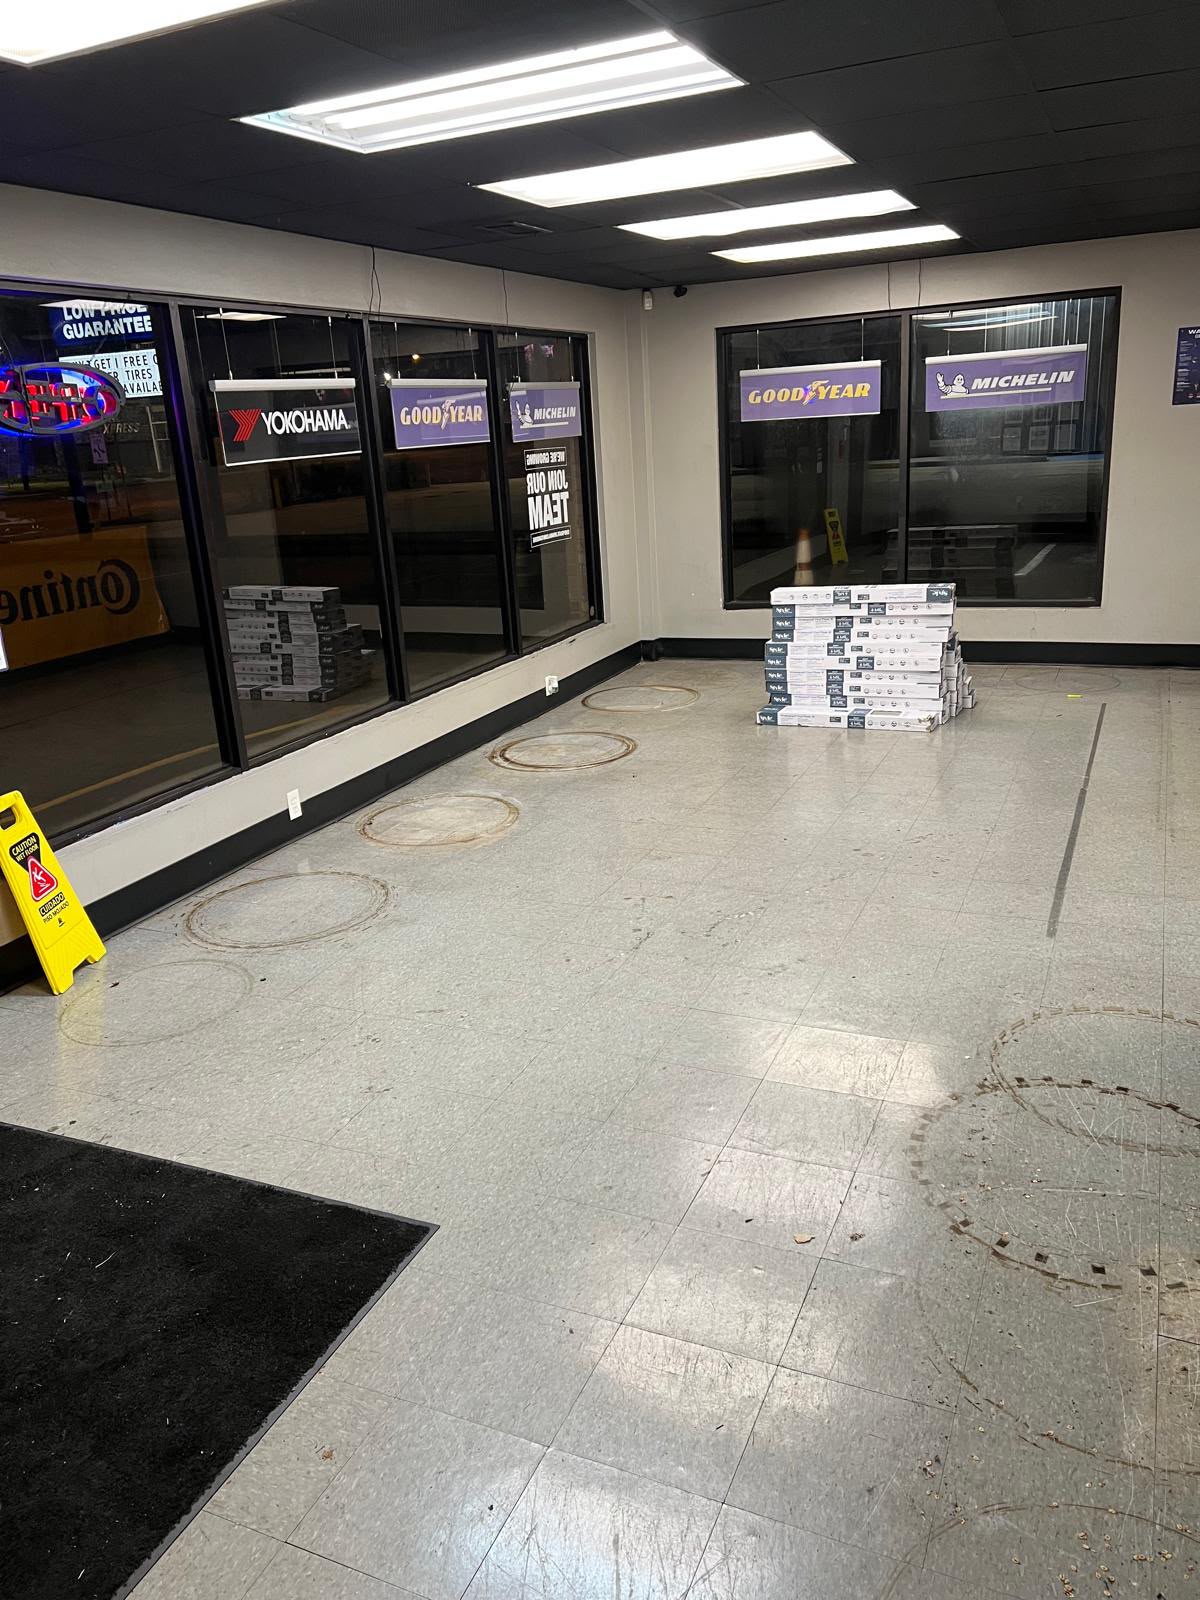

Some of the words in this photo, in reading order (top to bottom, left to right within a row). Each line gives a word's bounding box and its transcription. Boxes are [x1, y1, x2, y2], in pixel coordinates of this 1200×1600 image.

[62, 315, 153, 340] GUARANTEE
[94, 358, 111, 370] GET
[123, 354, 149, 368] FREE
[125, 368, 153, 381] TIRES
[971, 370, 1076, 391] MICHELIN
[261, 409, 348, 435] YOKOHAMA
[533, 406, 577, 420] MICHELIN
[12, 836, 37, 856] CAUTION
[16, 852, 26, 862] WET
[26, 844, 39, 857] FLOOR
[40, 894, 64, 915] CUIDADO
[43, 914, 53, 924] PISO
